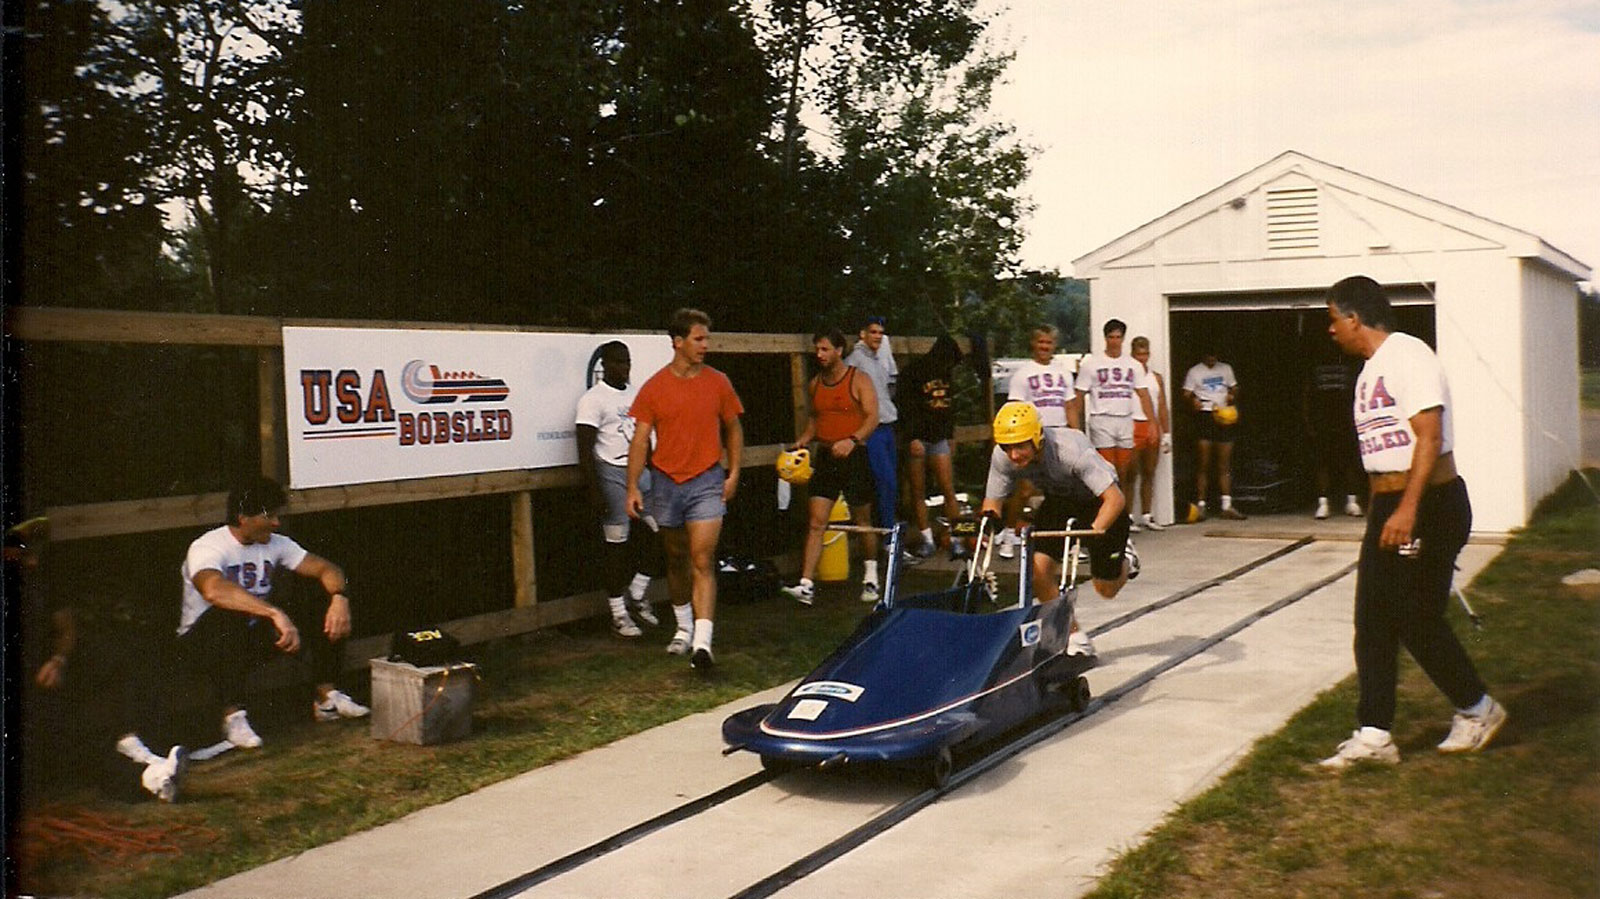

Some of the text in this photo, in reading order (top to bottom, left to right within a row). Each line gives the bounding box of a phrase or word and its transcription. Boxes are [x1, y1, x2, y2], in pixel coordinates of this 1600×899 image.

[1028, 373, 1067, 390] USA
[1097, 368, 1134, 383] USA
[301, 370, 396, 425] USA
[399, 409, 512, 445] BOBSLED
